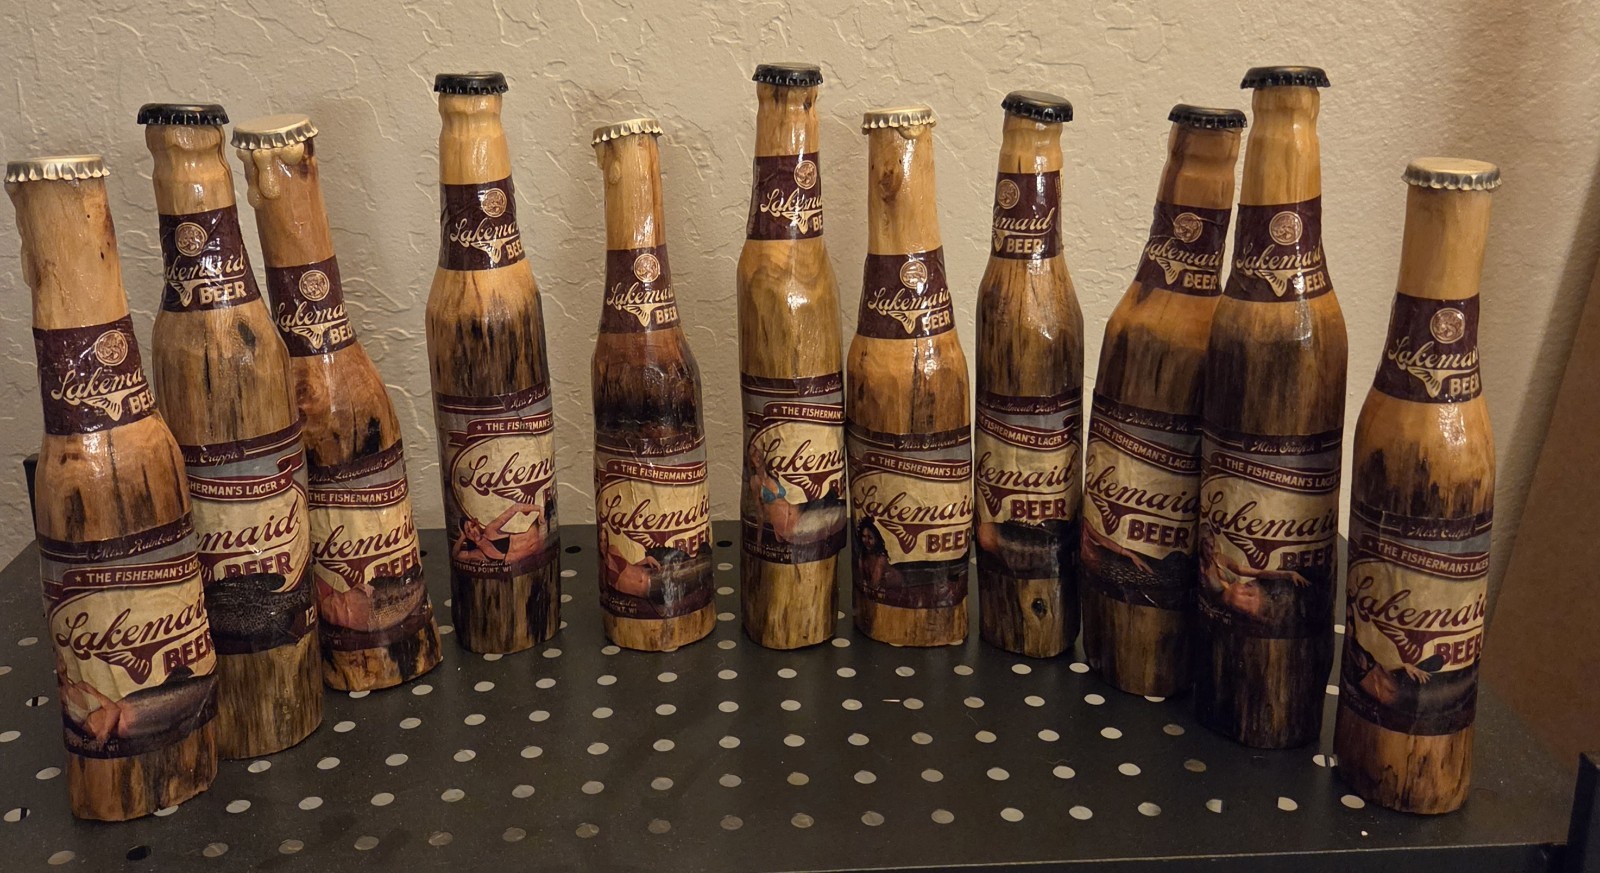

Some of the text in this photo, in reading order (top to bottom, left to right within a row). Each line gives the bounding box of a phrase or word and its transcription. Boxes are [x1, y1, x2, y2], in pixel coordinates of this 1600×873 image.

[1236, 238, 1320, 276] Lakemaid
[1183, 271, 1217, 290] BEER
[200, 281, 247, 305] BEER
[868, 288, 949, 316] Lakemaid
[781, 406, 800, 415] THE
[486, 422, 505, 431] THE
[984, 418, 1036, 444] FISHERMAN'S
[1038, 434, 1062, 446] LAGER
[1099, 423, 1111, 437] THE
[1111, 431, 1167, 462] FISHERMAN'S
[621, 464, 637, 475] THE
[640, 467, 692, 480] FISHERMAN'S
[879, 457, 895, 467] THE
[898, 462, 950, 476] FISHERMAN'S
[1225, 458, 1244, 472] THE
[1247, 465, 1313, 487] FISHERMAN'S
[246, 481, 278, 495] LAGER
[309, 493, 327, 502] THE
[329, 491, 388, 504] FISHERMAN'S
[1010, 498, 1067, 520] BEER
[1127, 518, 1191, 549] BEER
[1377, 541, 1397, 557] THE
[1400, 551, 1469, 574] FISHERMAN'S
[86, 572, 112, 583] THE
[115, 565, 183, 583] FISHERMAN'S
